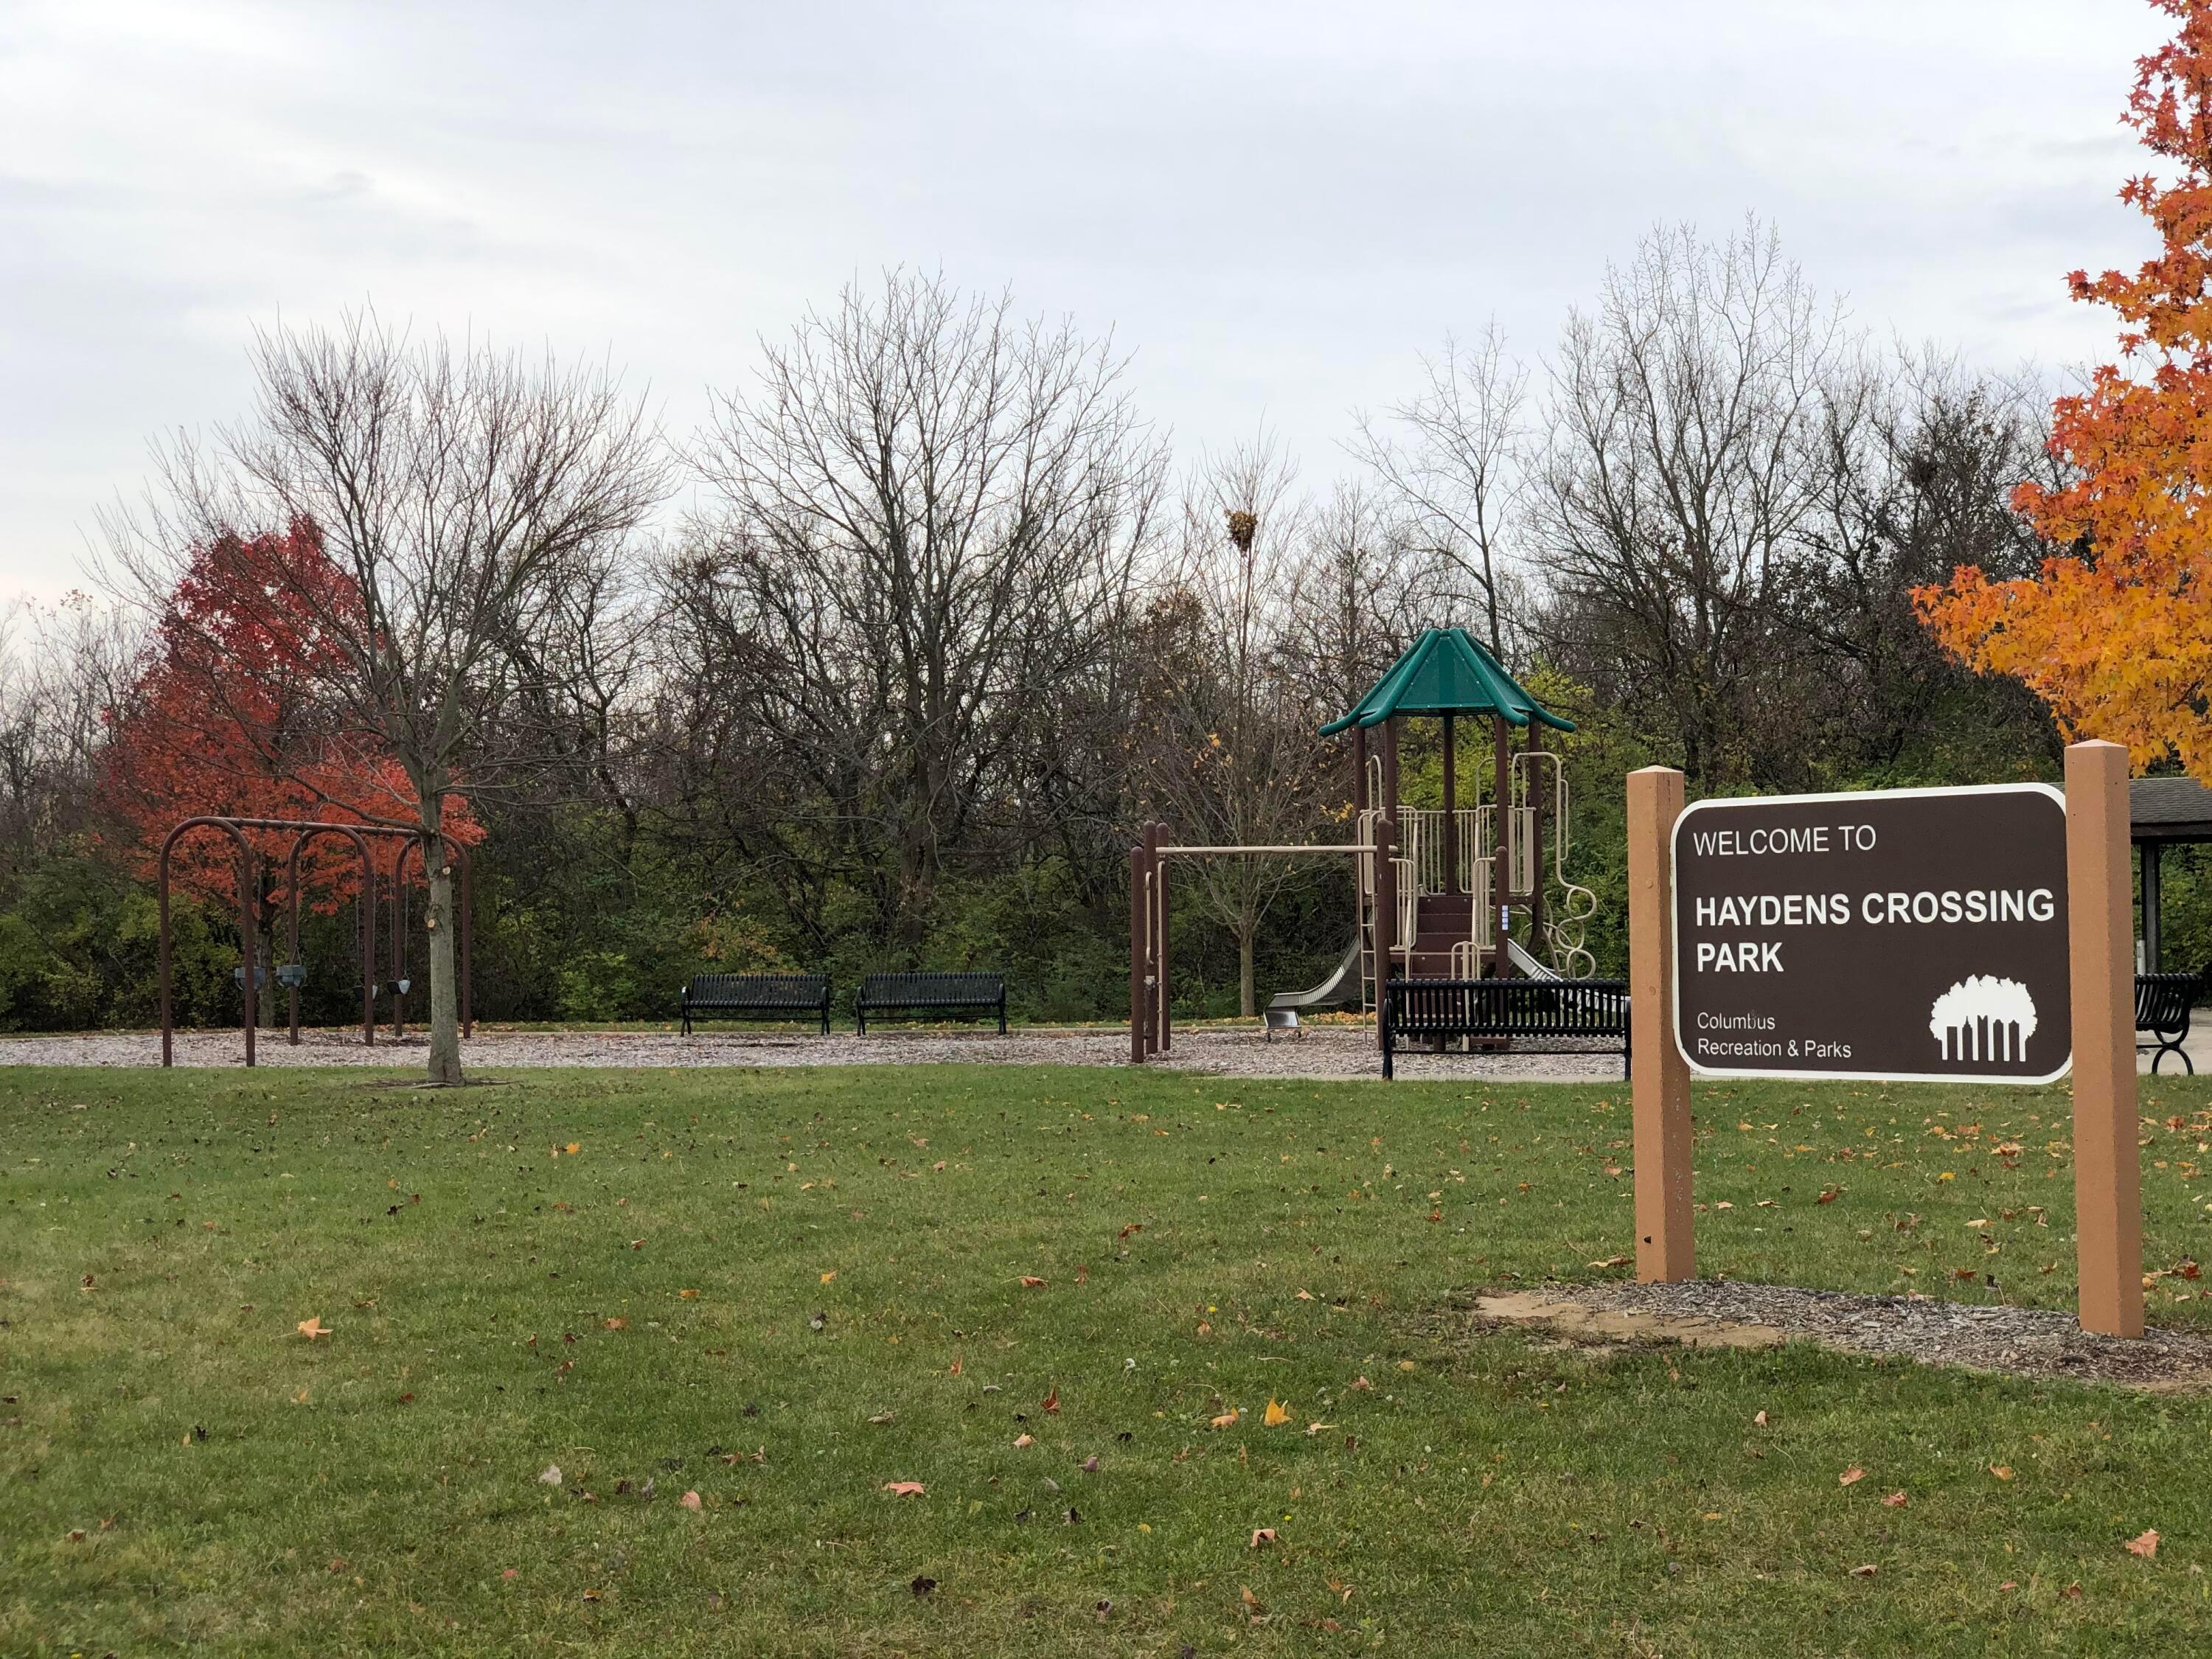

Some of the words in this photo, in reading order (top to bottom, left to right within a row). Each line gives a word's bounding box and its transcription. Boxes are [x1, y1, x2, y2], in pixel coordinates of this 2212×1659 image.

[1693, 827, 1830, 857] WELCOME
[1837, 824, 1877, 851] TO
[1696, 893, 1851, 927] HAYDENS
[1862, 888, 2055, 925] CROSSING
[1697, 942, 1784, 973] PARK
[1697, 1012, 1775, 1030] Columbus
[1698, 1037, 1781, 1057] Recreation
[1787, 1039, 1799, 1057] &
[1804, 1040, 1851, 1058] Parks
